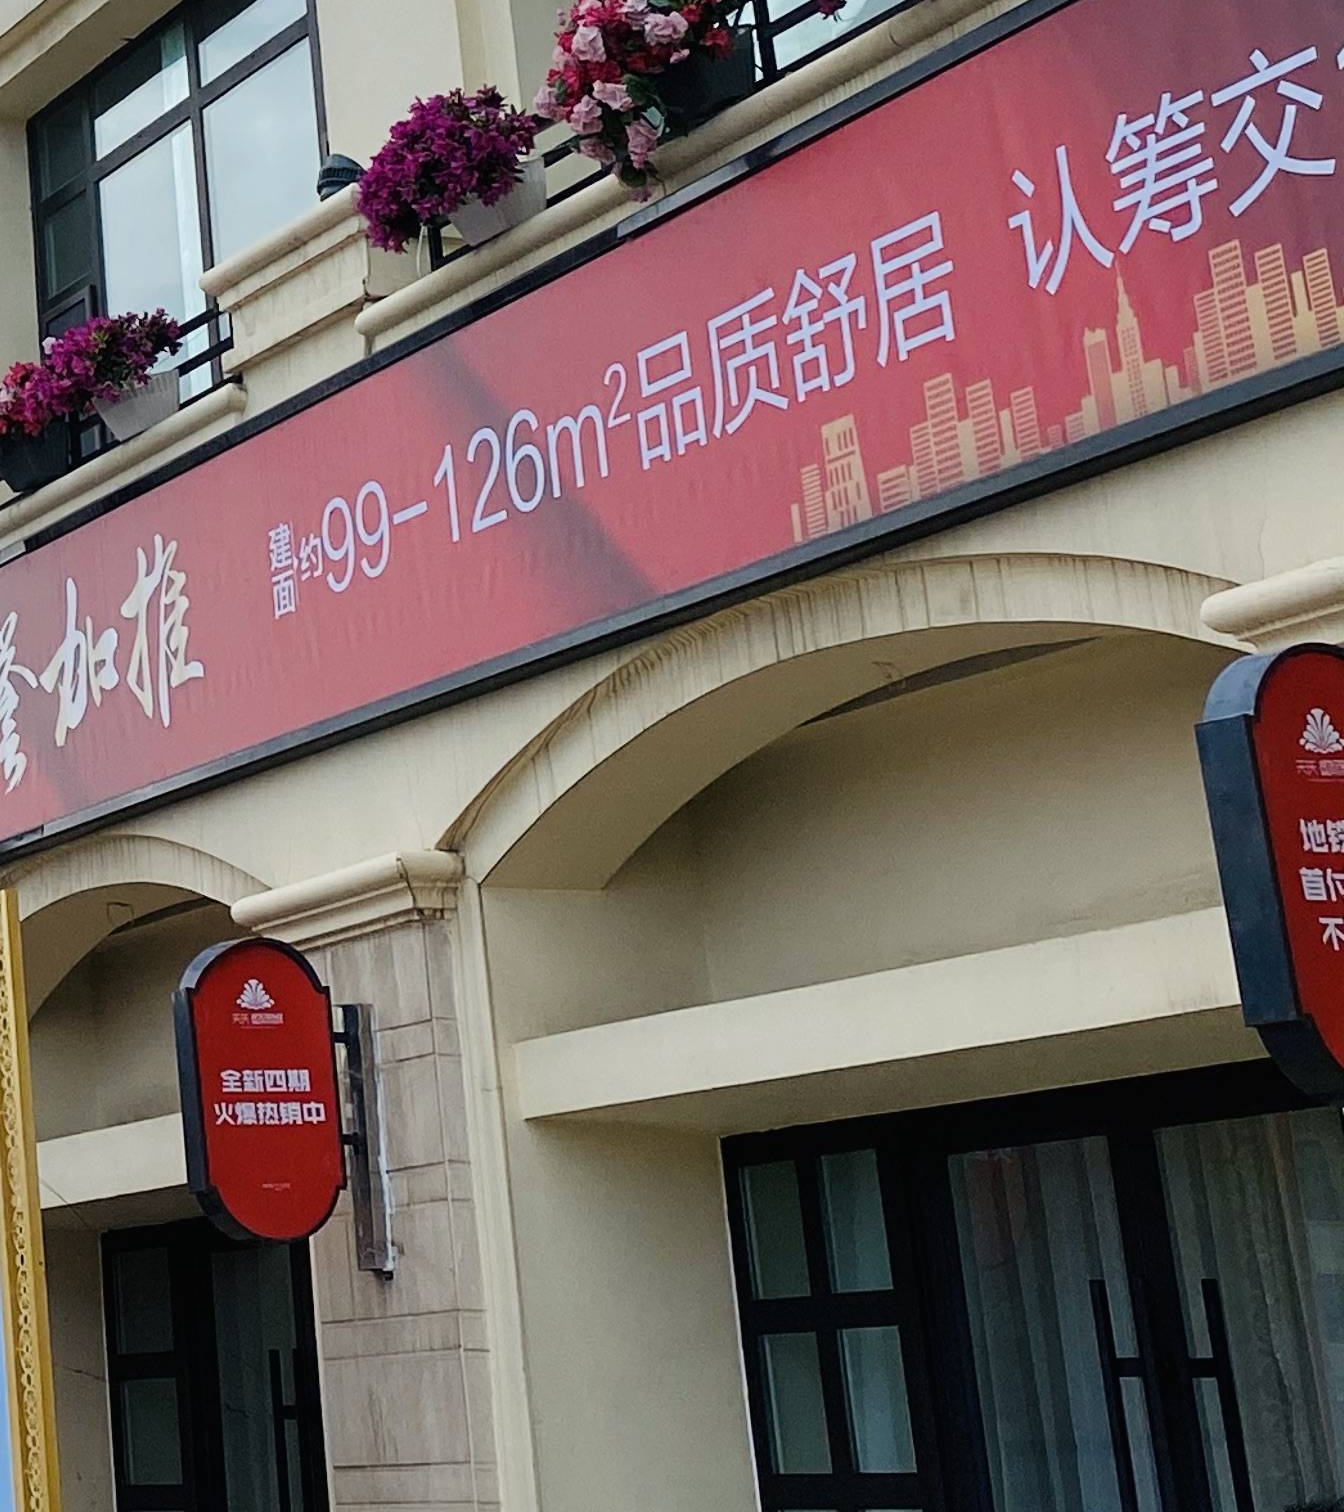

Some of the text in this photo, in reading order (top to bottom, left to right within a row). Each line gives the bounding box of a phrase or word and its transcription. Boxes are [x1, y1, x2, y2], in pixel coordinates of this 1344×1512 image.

[1008, 45, 1344, 295] 认筹交
[220, 1069, 311, 1093] 全新四期
[214, 1101, 327, 1125] 火爆热销中
